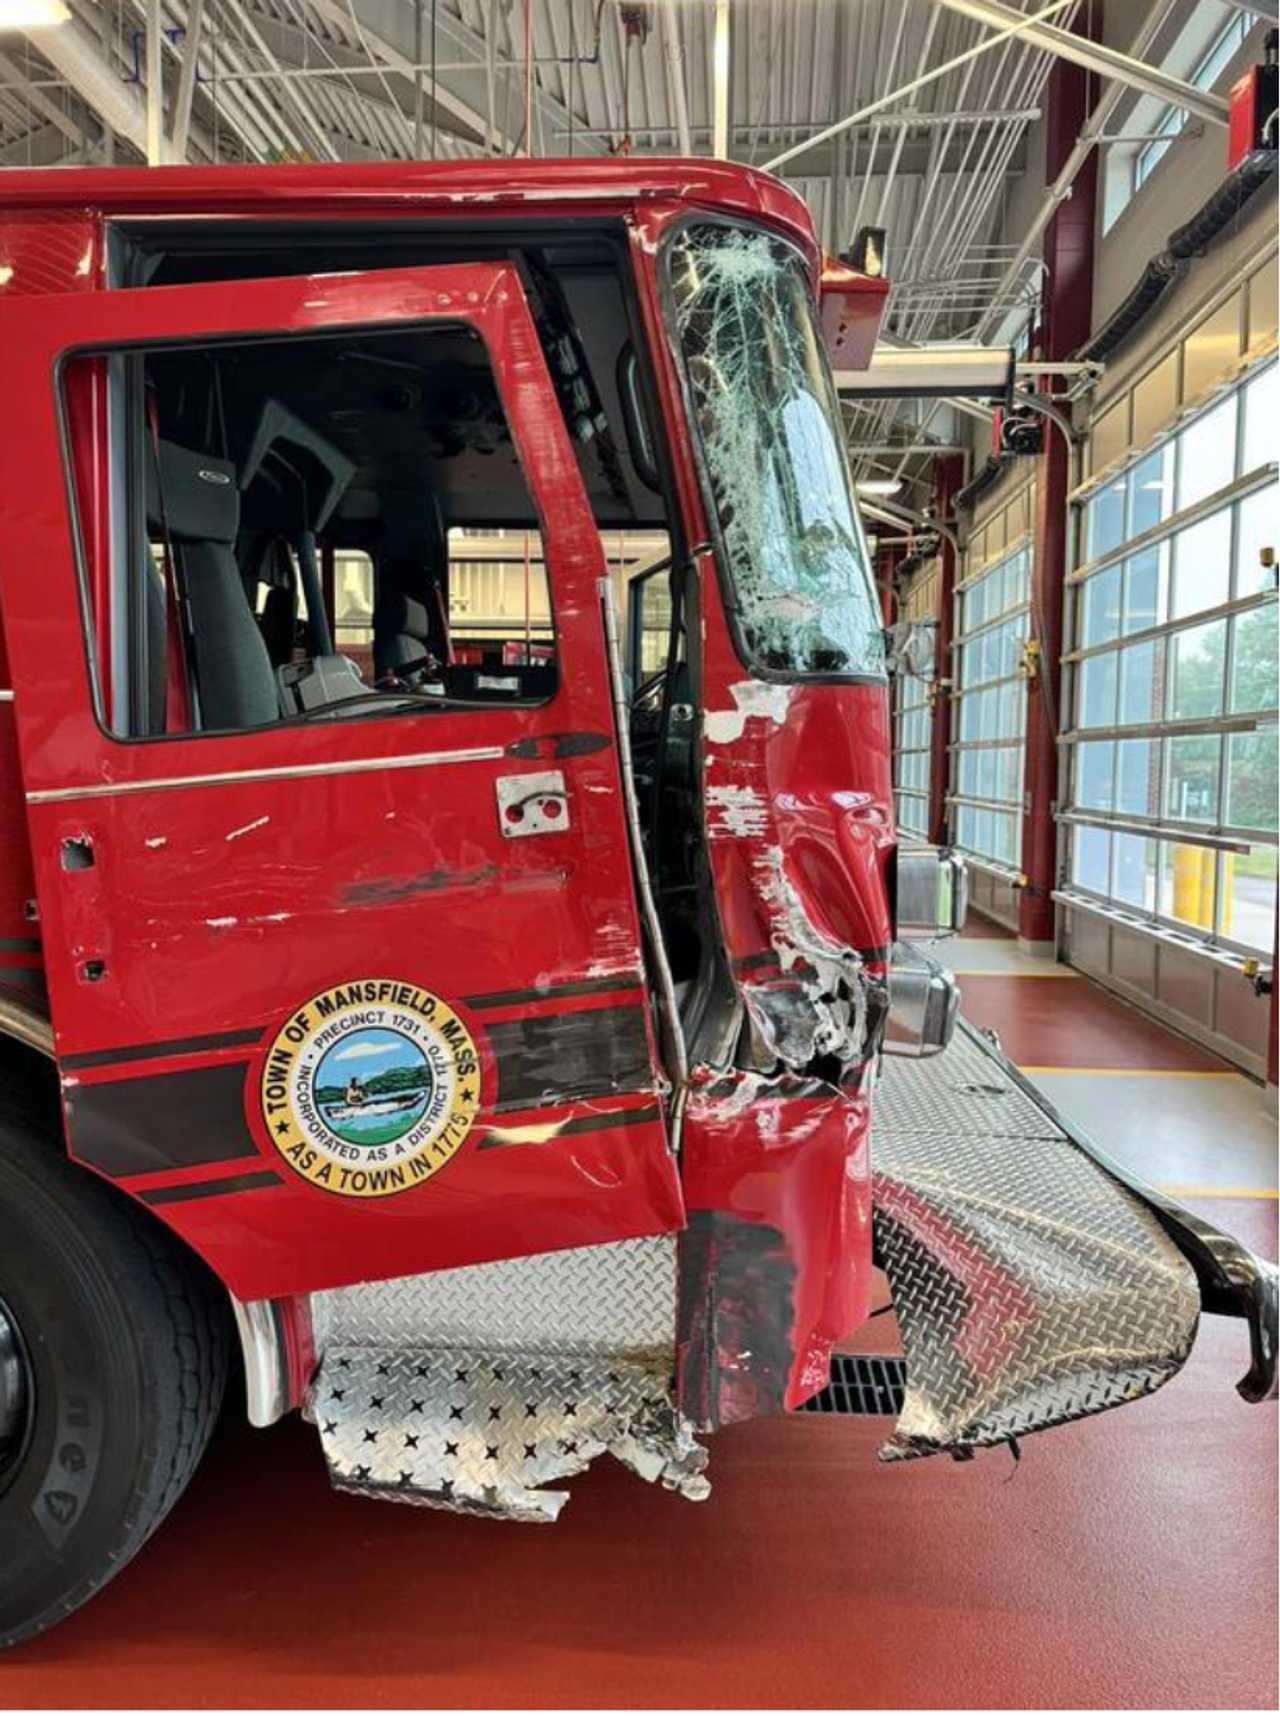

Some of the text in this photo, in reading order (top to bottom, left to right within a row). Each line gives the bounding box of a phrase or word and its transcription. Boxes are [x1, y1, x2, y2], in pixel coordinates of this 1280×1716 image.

[265, 982, 476, 1114] TOWN OF MANSFIELD, MASS.
[313, 1011, 420, 1050] PRECINCT 1731
[286, 1114, 469, 1192] AS A TOWN IN 1775
[297, 1064, 360, 1160] INCORPORATED
[366, 1147, 388, 1161] AS
[395, 1143, 406, 1155] A
[408, 1084, 449, 1145] DISTRICT
